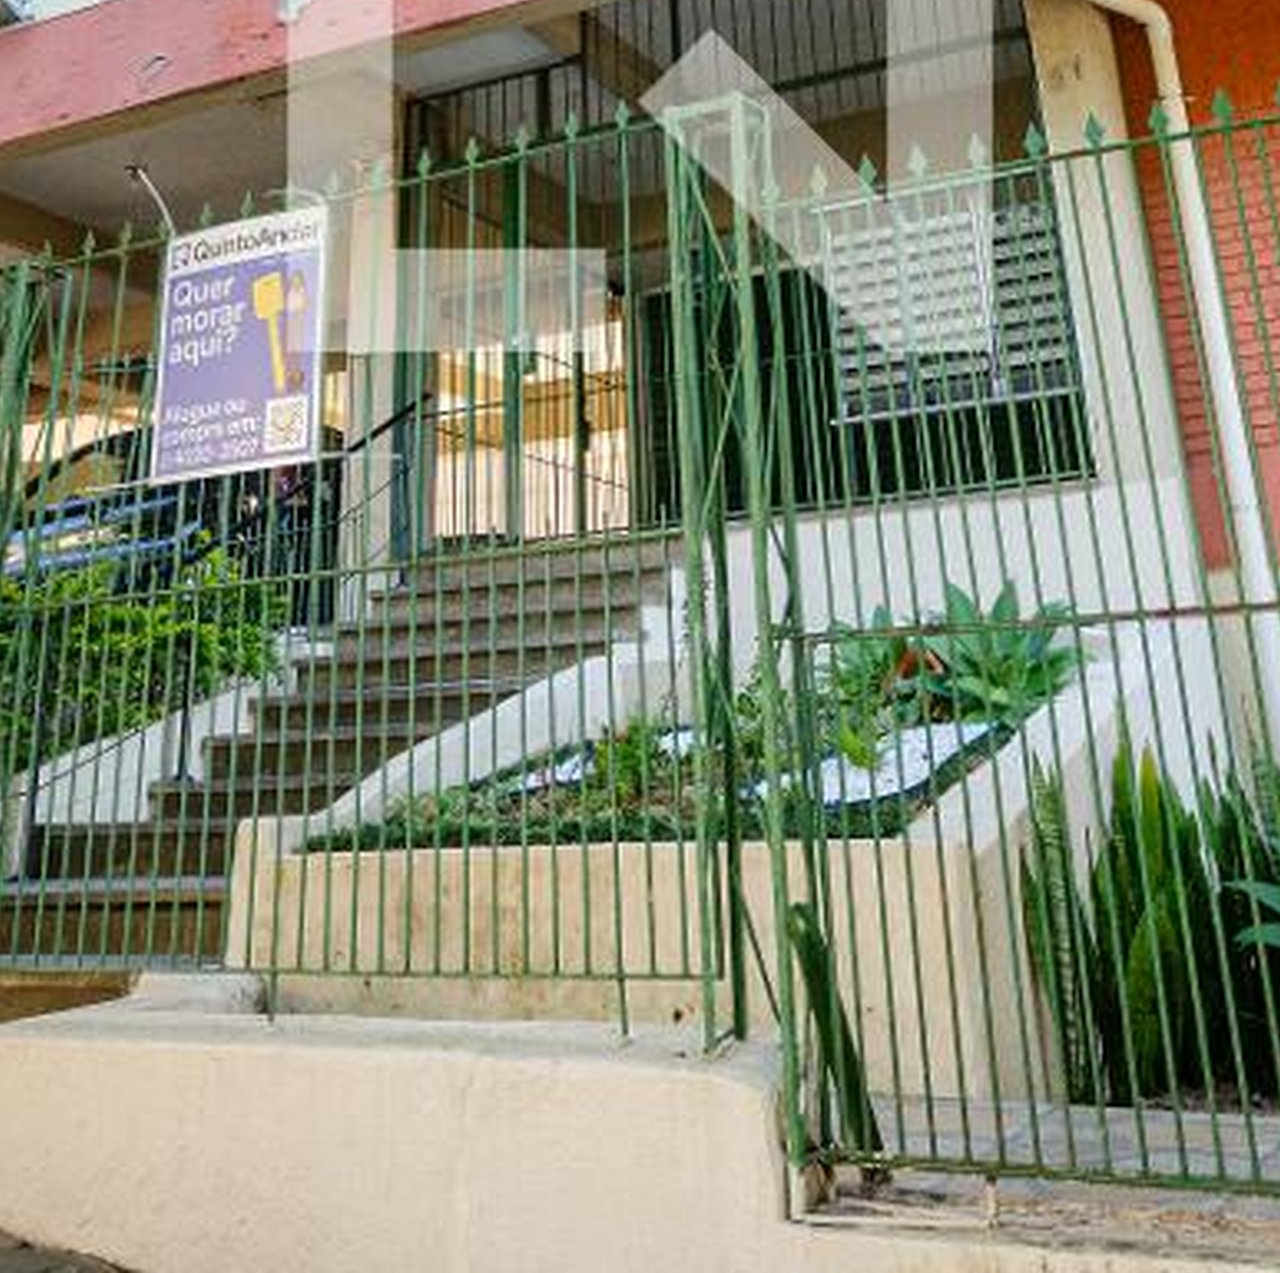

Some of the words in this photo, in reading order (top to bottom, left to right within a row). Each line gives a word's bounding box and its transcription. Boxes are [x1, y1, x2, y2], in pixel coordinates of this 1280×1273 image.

[173, 277, 236, 308] Quer
[170, 300, 247, 336] morar
[169, 327, 237, 366] aqui?
